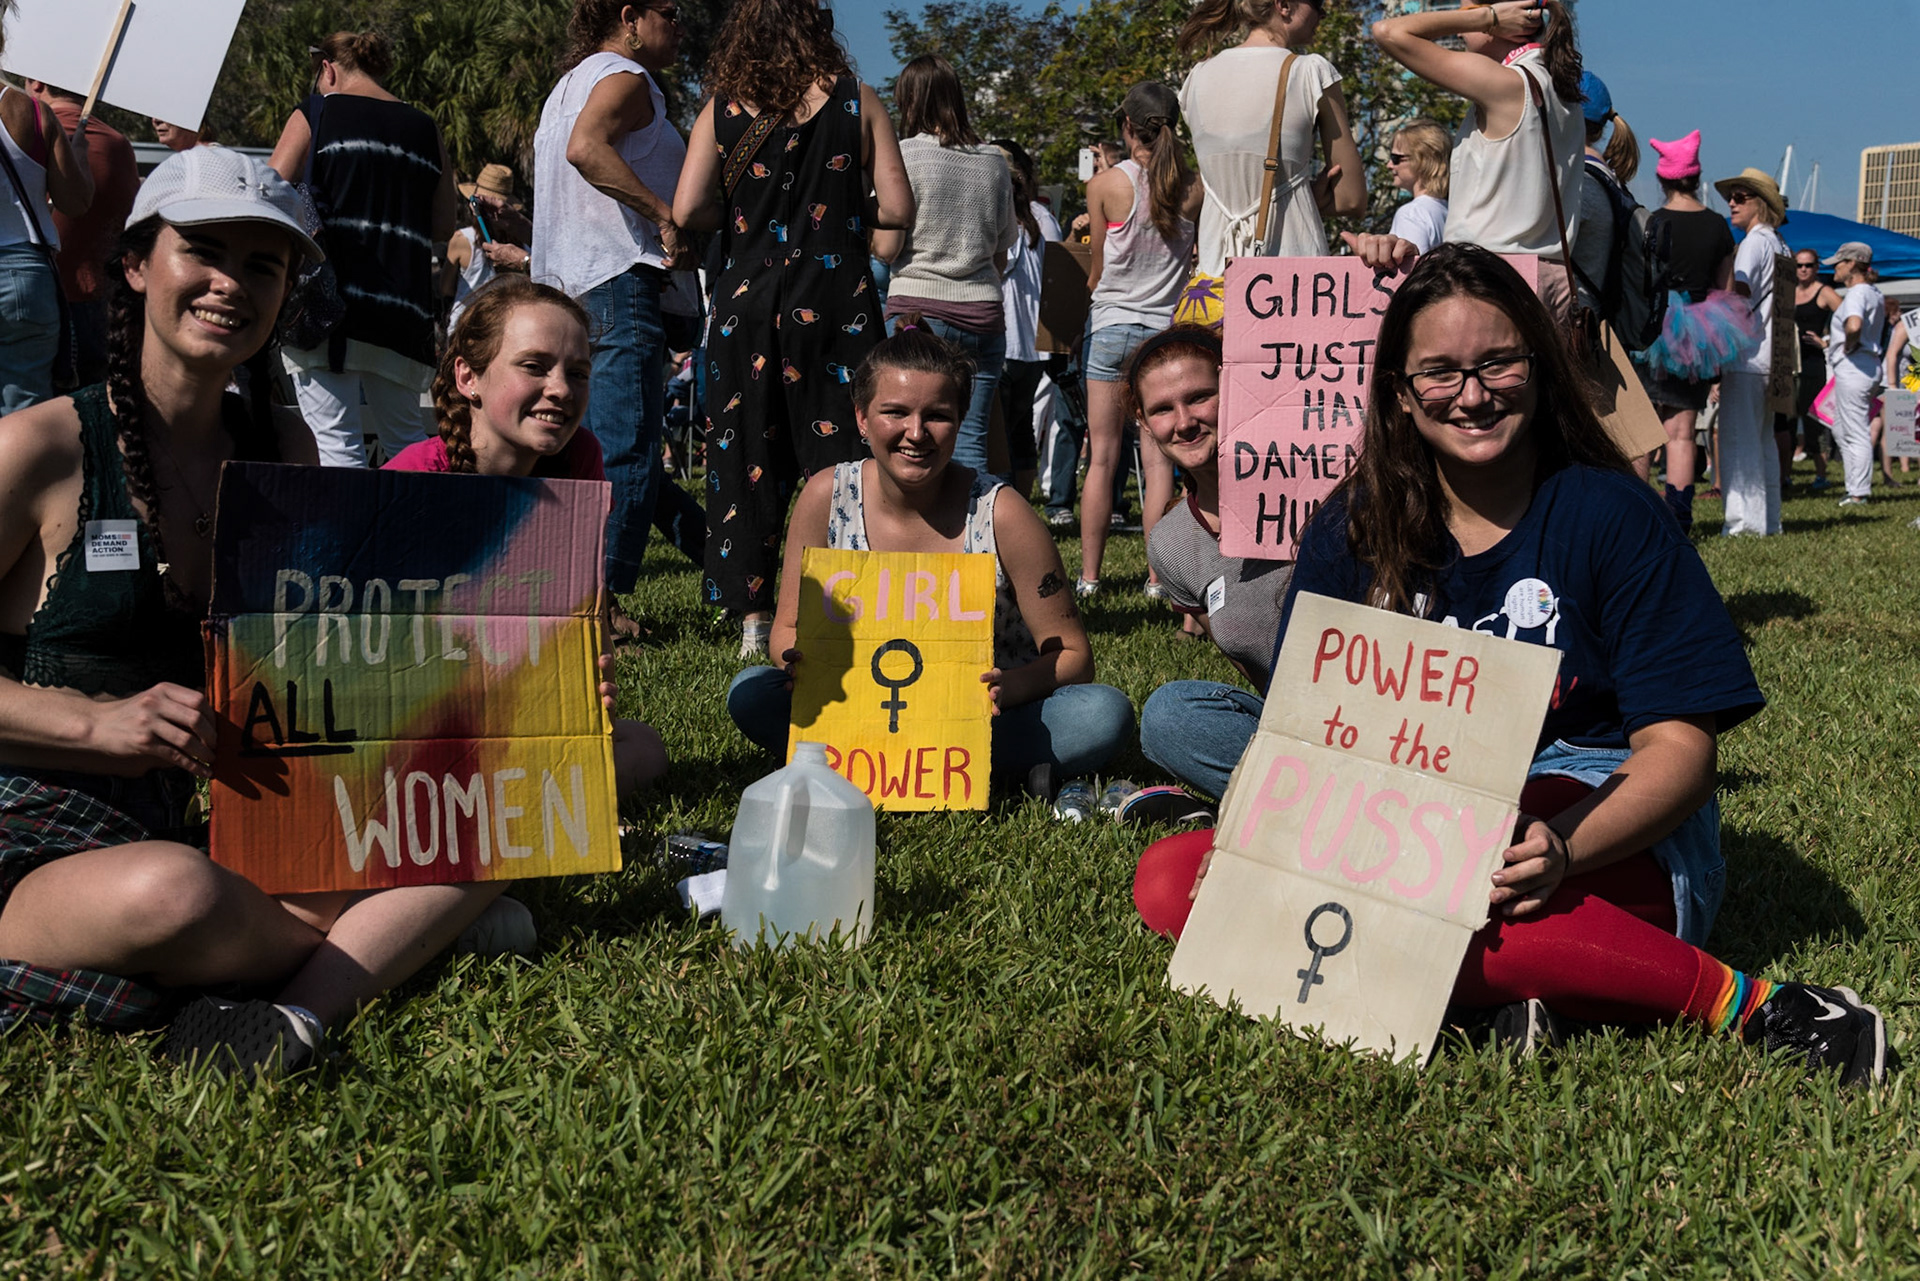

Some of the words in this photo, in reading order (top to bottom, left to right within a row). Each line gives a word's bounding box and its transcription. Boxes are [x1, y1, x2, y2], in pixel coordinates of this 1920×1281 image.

[1245, 271, 1397, 320] GIRLS
[1905, 311, 1919, 329] IF
[1261, 339, 1376, 386] JUST
[273, 568, 555, 669] PROTECT
[823, 569, 986, 624] GIRL
[1312, 627, 1480, 714] POWER
[240, 678, 357, 750] ALL
[1323, 705, 1358, 749] to
[1389, 718, 1451, 773] the
[334, 764, 590, 873] WOMEN
[1239, 755, 1517, 914] PUSSY
